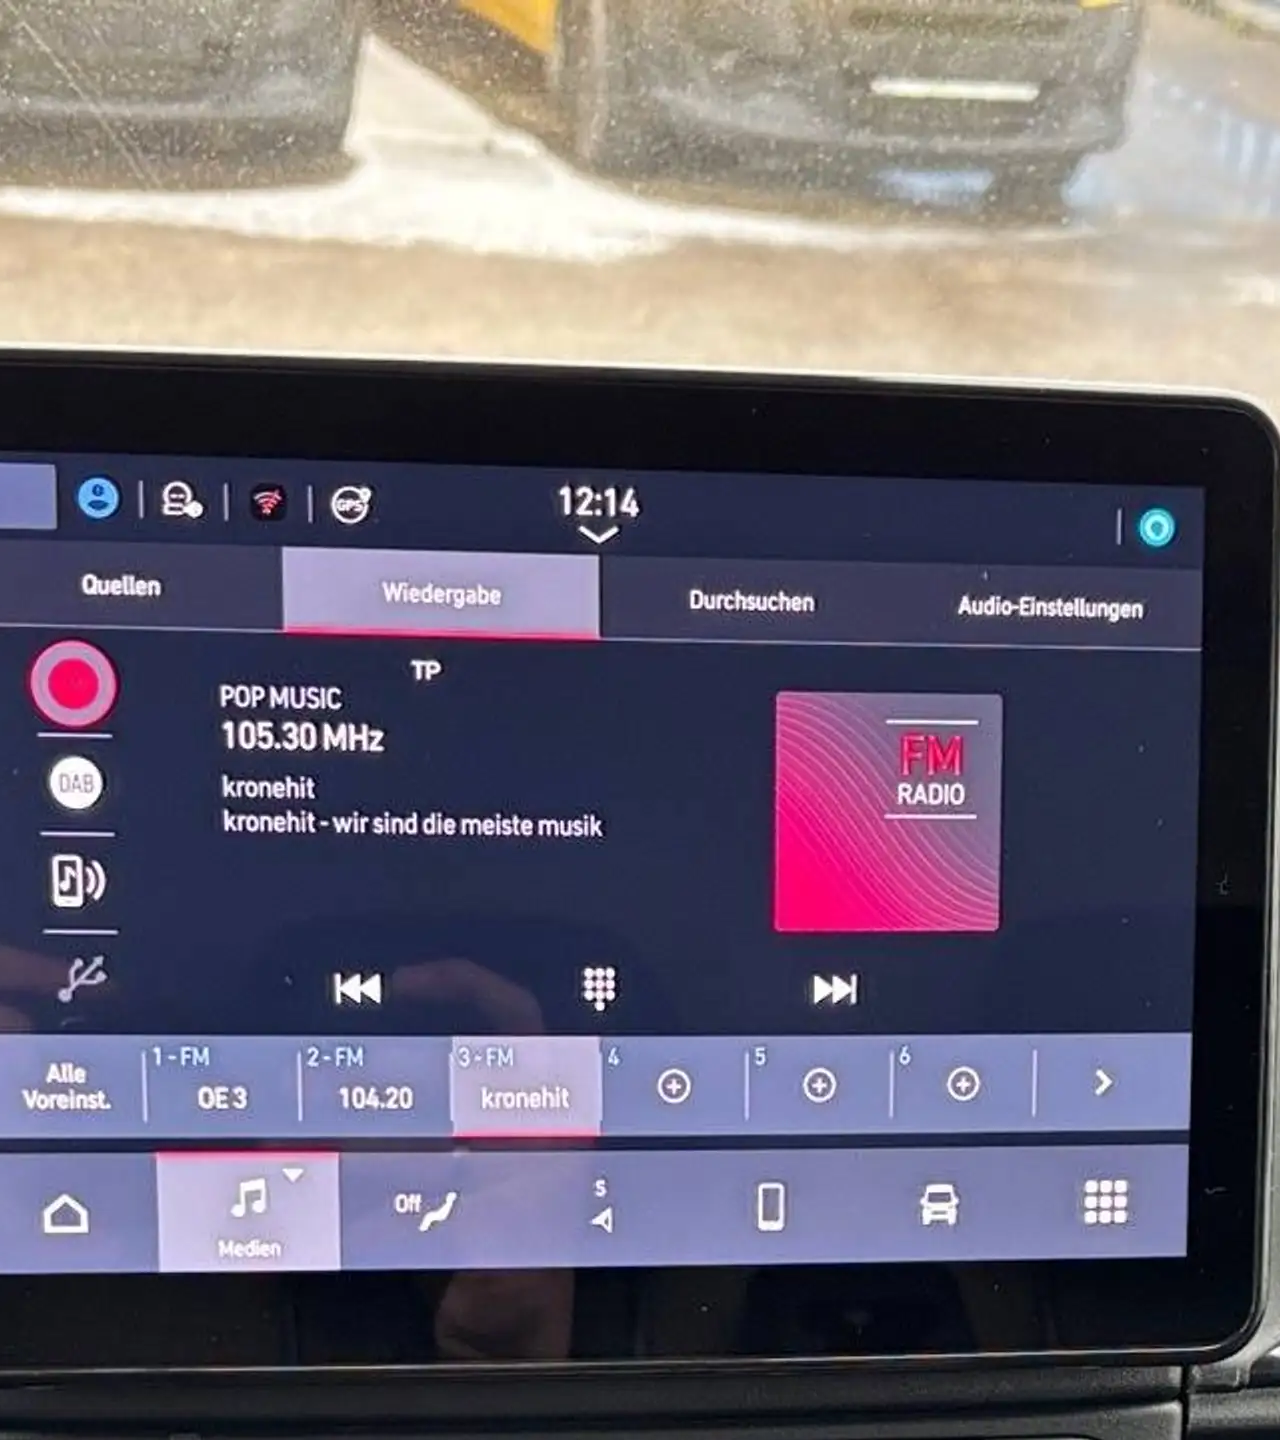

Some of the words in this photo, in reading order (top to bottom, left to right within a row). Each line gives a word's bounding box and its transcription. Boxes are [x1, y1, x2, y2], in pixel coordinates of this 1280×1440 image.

[558, 486, 639, 518] 12:14
[82, 574, 161, 598] Quellen
[382, 582, 501, 608] Wiedergabe
[689, 590, 814, 612] Durchsuchen
[958, 597, 1143, 621] Audio-Einstellungen
[411, 660, 441, 681] TP
[220, 685, 265, 708] POP
[269, 686, 341, 710] MUSIC
[222, 721, 316, 751] 105.30
[323, 723, 384, 752] MHz
[899, 734, 962, 776] FM
[59, 772, 94, 794] DAB
[222, 776, 314, 800] kronehit
[897, 783, 965, 806] RADIO
[223, 811, 315, 834] kronehit
[333, 813, 368, 835] wir
[373, 814, 417, 836] sind
[422, 814, 455, 836] die
[460, 815, 533, 836] meiste
[538, 815, 603, 836] musik
[608, 1047, 619, 1066] 4
[755, 1046, 766, 1066] 5
[899, 1045, 911, 1065] 6
[46, 1062, 85, 1085] Alle
[22, 1088, 111, 1110] Voreinst.
[339, 1087, 413, 1108] 104.20
[481, 1087, 569, 1109] kronehit
[593, 1180, 606, 1197] S
[395, 1194, 421, 1214] Off
[218, 1240, 281, 1258] Medien
